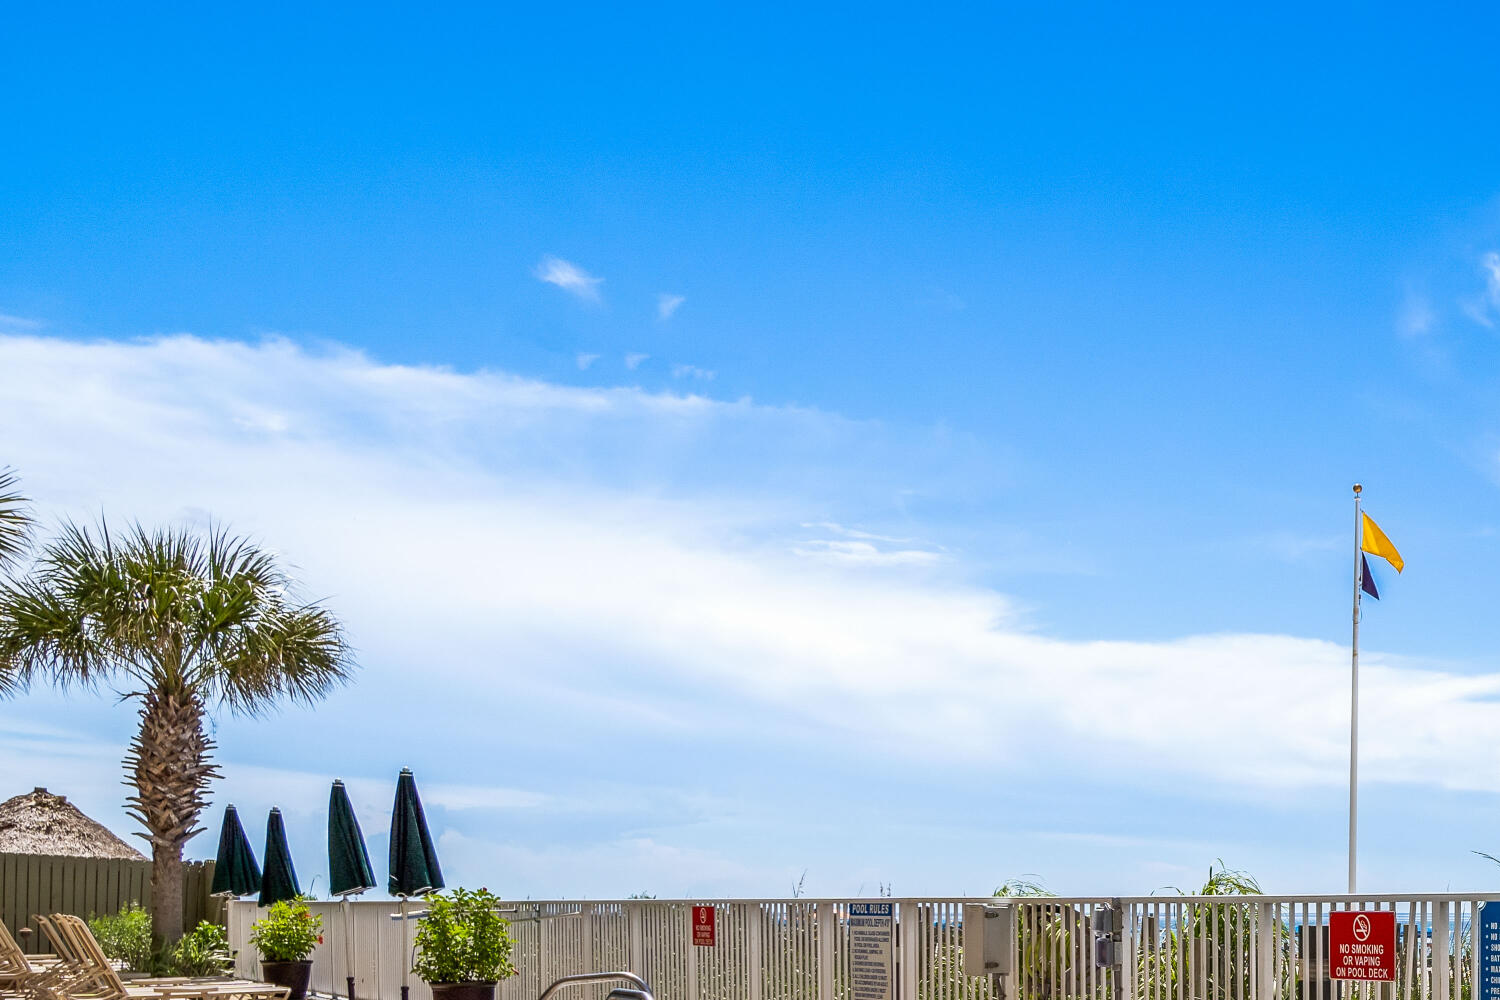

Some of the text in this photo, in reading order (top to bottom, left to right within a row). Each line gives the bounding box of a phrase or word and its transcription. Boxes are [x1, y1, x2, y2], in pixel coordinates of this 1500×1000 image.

[852, 904, 889, 914] POOL RULES
[1340, 944, 1383, 954] NO SMOKING
[1343, 956, 1380, 966] OR VAPING
[1336, 968, 1388, 978] ON POOL DECK
